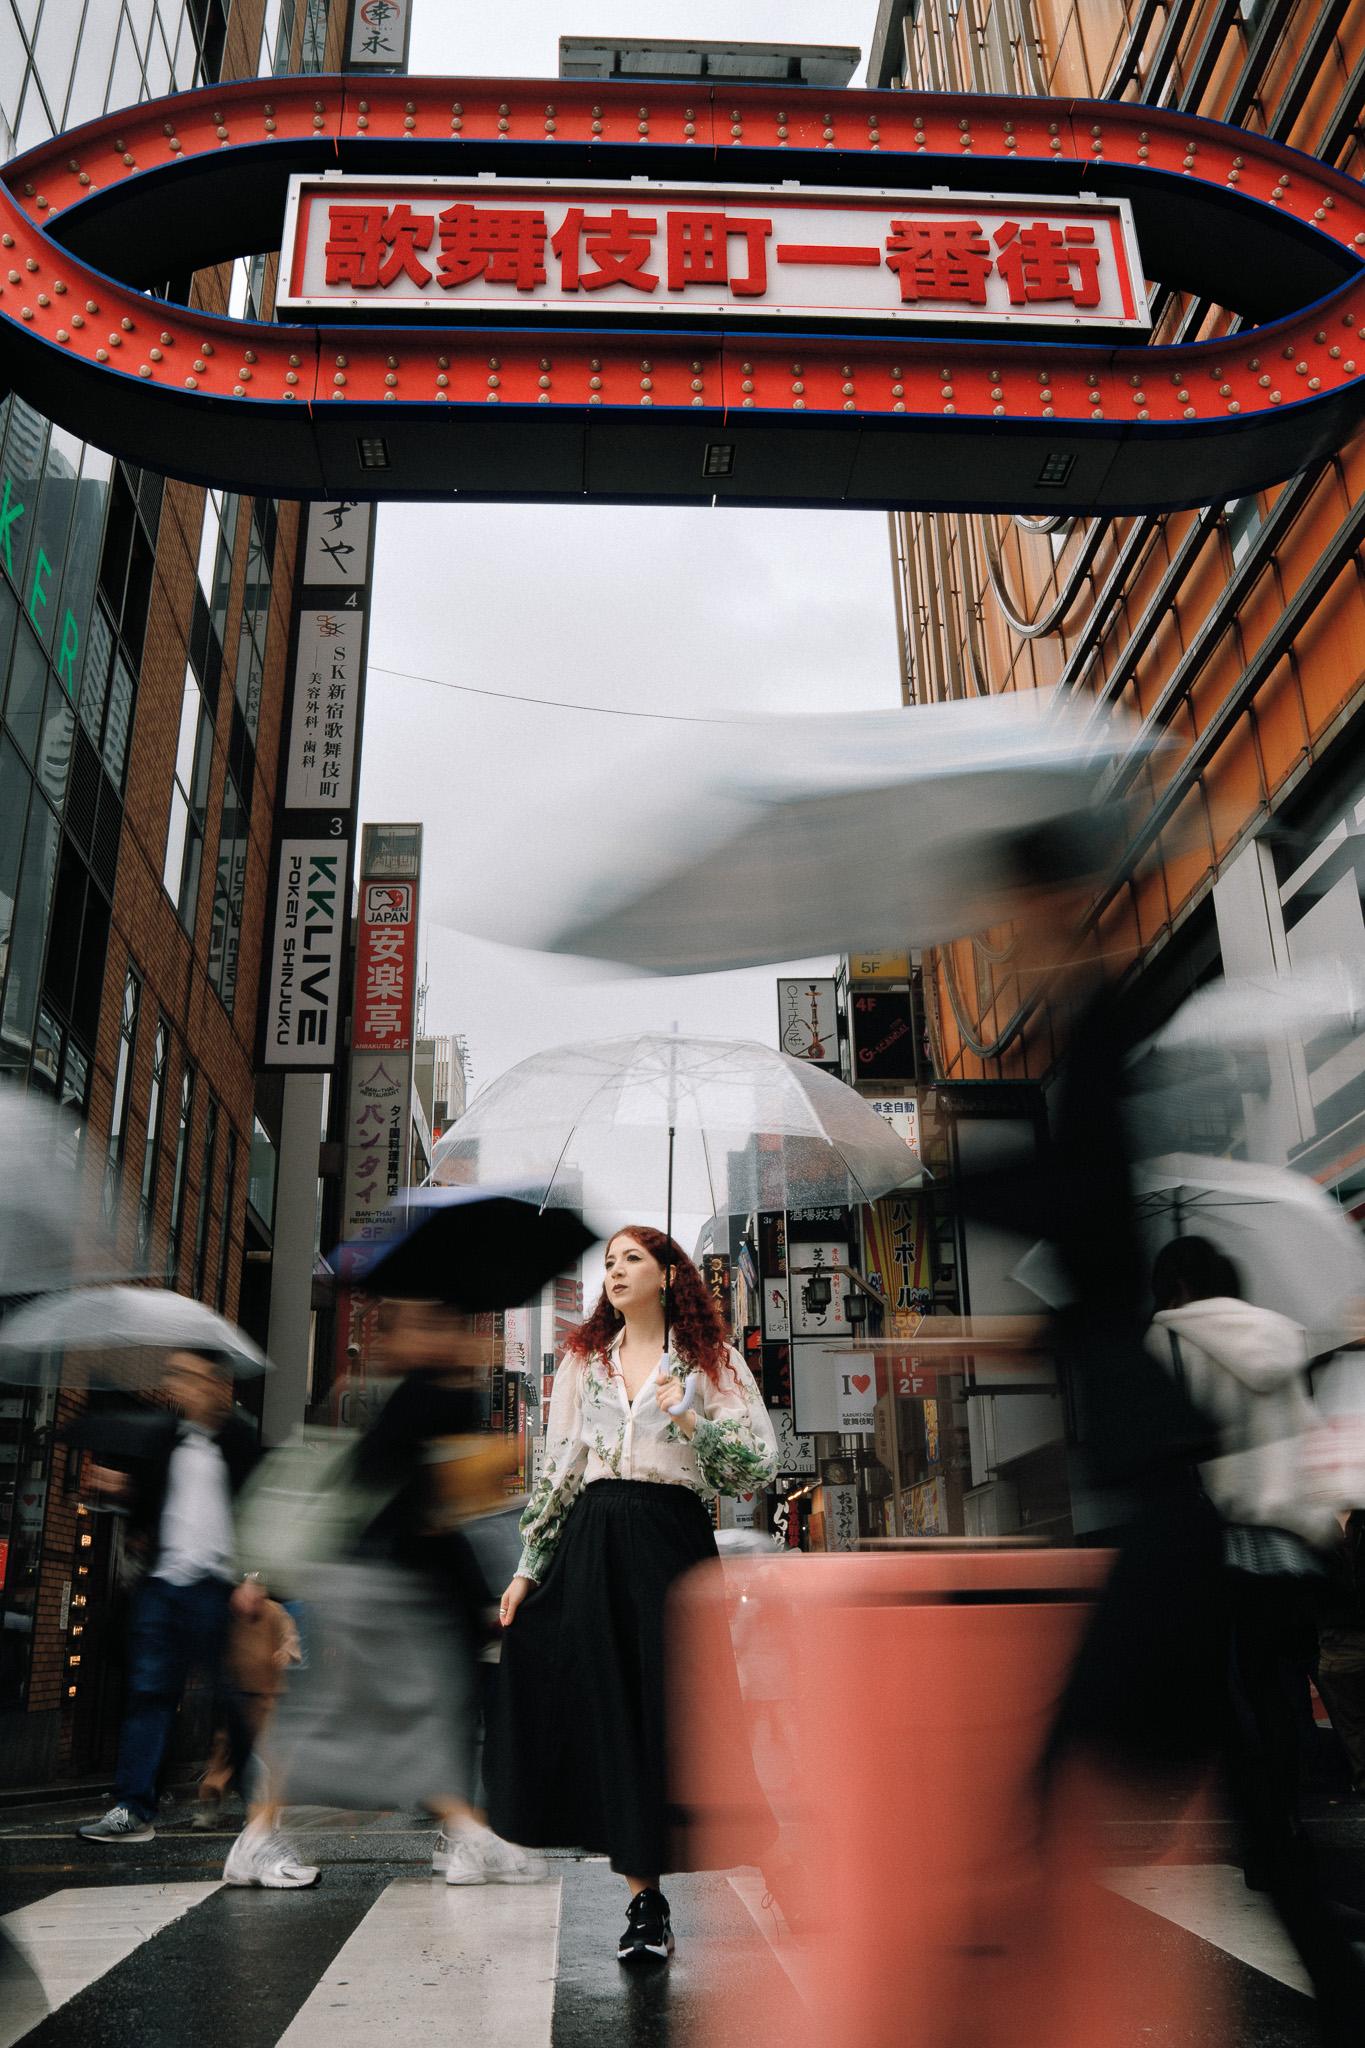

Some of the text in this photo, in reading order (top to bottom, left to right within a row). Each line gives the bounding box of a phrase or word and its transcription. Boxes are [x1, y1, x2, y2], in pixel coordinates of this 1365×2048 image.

[359, 1, 398, 54] 幸永
[324, 202, 1102, 308] 歌舞伎町一番街
[344, 592, 358, 608] 4
[319, 646, 346, 799] SK新宿歌舞伎町
[329, 818, 343, 836] 3
[368, 912, 409, 923] JAPAN
[276, 856, 302, 1046] POKER SHINJUKU
[297, 856, 338, 1046] KKLIVE
[860, 961, 881, 974] 5F
[364, 928, 406, 1039] 安楽亭
[855, 997, 878, 1012] 4F
[393, 1038, 409, 1050] 2F
[355, 1104, 385, 1204] バンタイ
[360, 1226, 386, 1239] 3F
[892, 1201, 917, 1309] ハイボール
[841, 1375, 852, 1396] I
[899, 1378, 924, 1394] 2F
